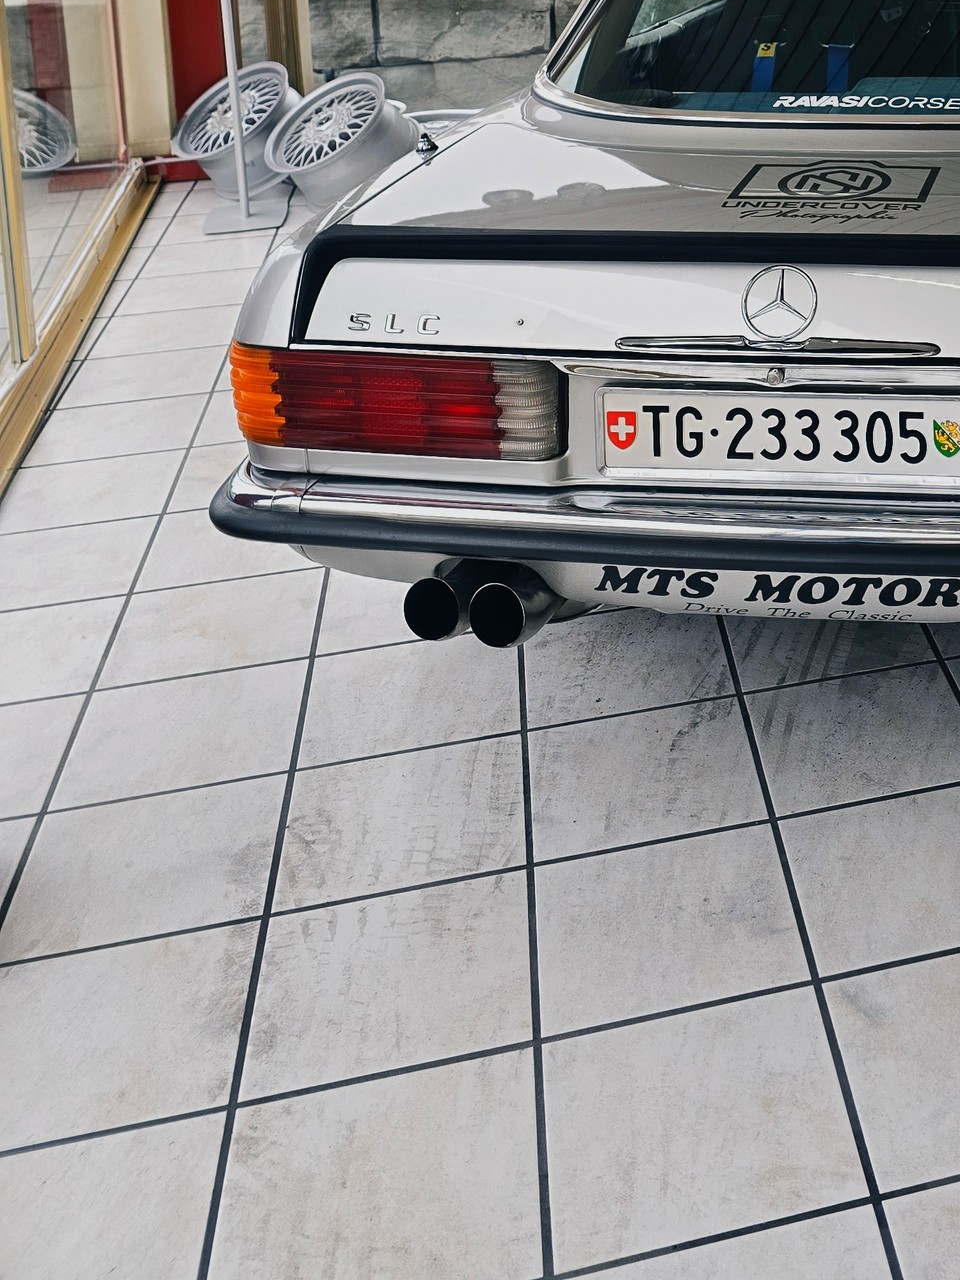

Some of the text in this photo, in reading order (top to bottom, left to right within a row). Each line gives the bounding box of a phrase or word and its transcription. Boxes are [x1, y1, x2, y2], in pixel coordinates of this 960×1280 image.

[721, 200, 922, 212] UNDERCOVER
[347, 312, 441, 336] SLC
[594, 565, 719, 599] MTS
[683, 602, 913, 621] Drive The Classic
